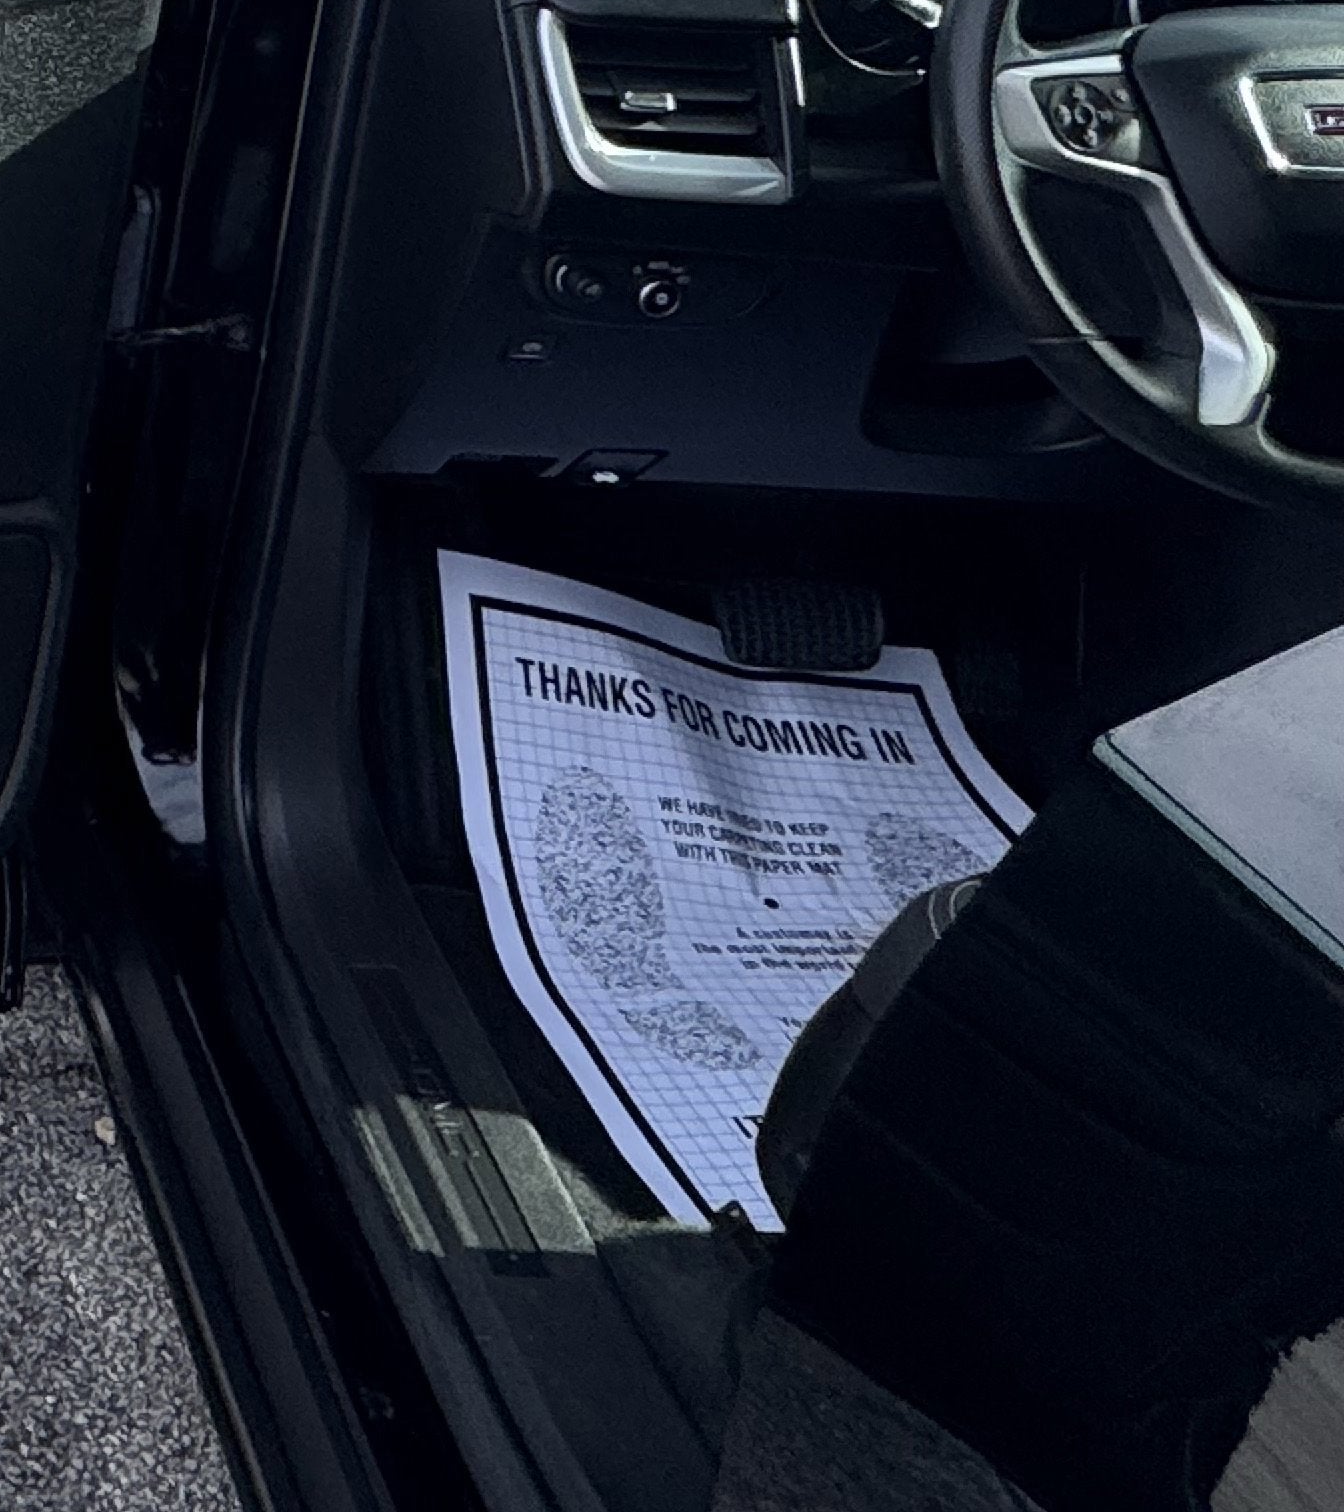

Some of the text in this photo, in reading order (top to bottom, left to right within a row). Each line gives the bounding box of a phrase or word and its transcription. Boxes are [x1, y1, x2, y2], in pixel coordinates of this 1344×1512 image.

[515, 655, 915, 765] THANKS FOR COMING IN
[661, 818, 706, 838] YOUR
[788, 822, 830, 837] KEEP
[673, 840, 717, 862] WITH
